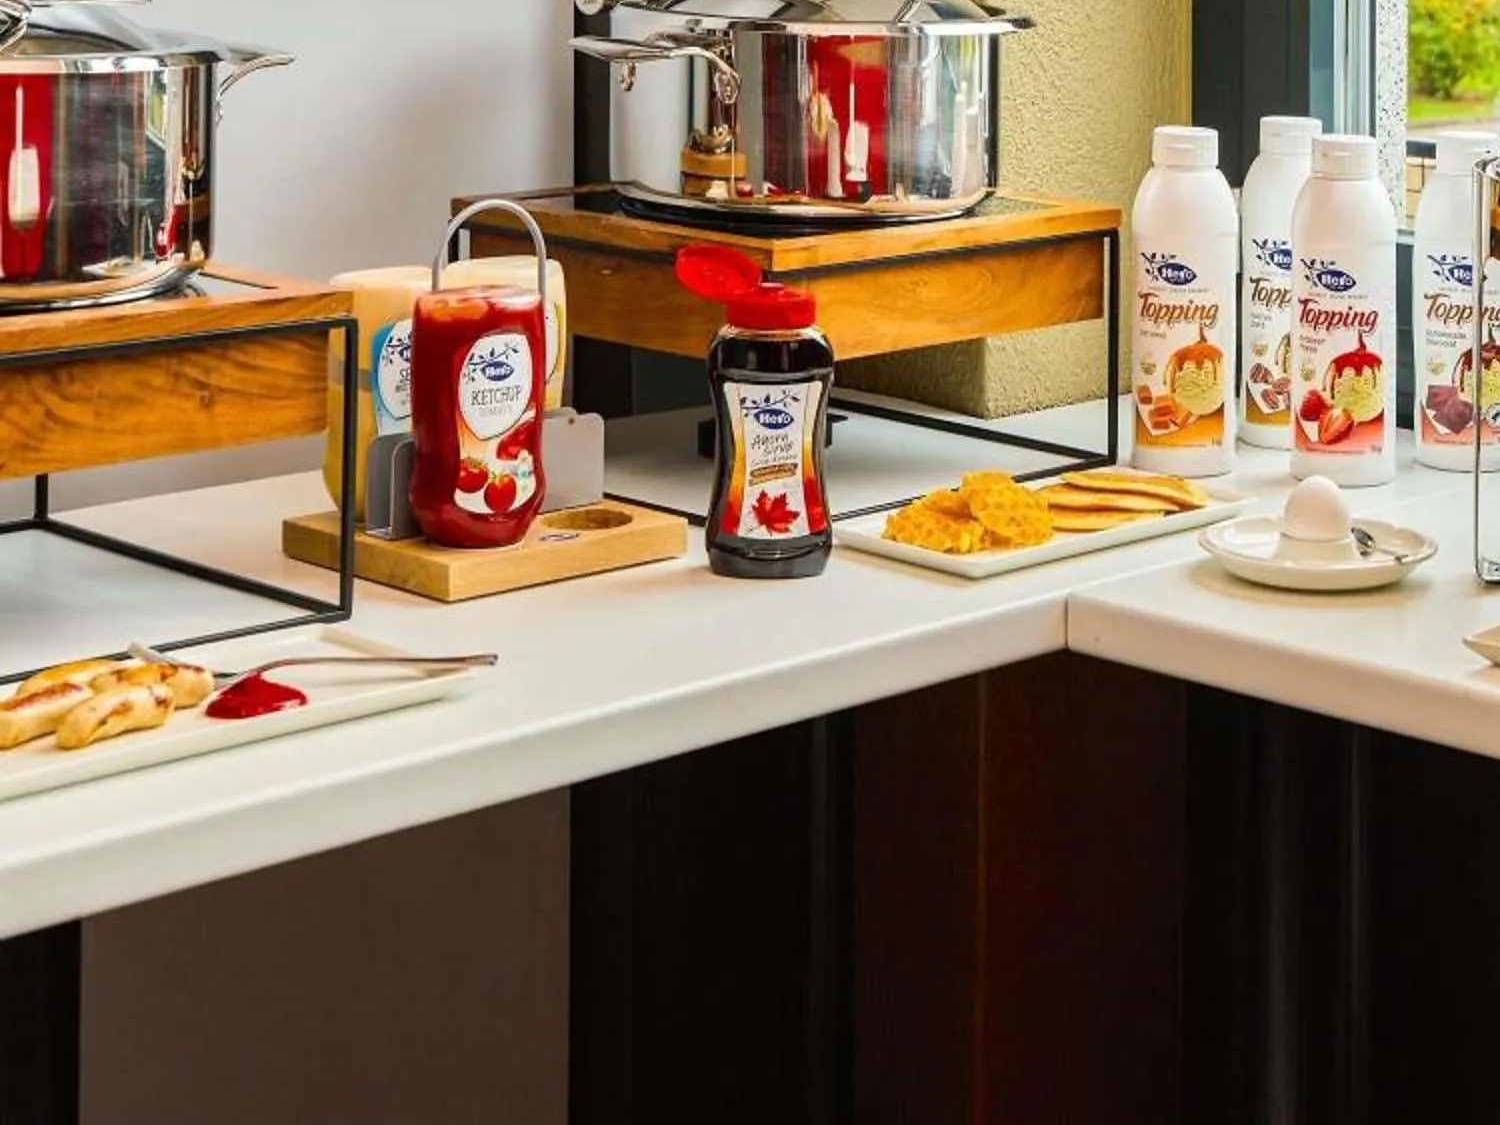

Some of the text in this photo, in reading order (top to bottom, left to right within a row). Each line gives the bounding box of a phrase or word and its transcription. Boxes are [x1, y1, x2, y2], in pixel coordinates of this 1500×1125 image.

[1250, 276, 1292, 308] Topp
[1321, 274, 1353, 286] Hero
[1138, 291, 1219, 328] Topping
[1298, 297, 1378, 333] Topping
[471, 384, 522, 406] KETCHUP
[760, 412, 791, 424] Hero
